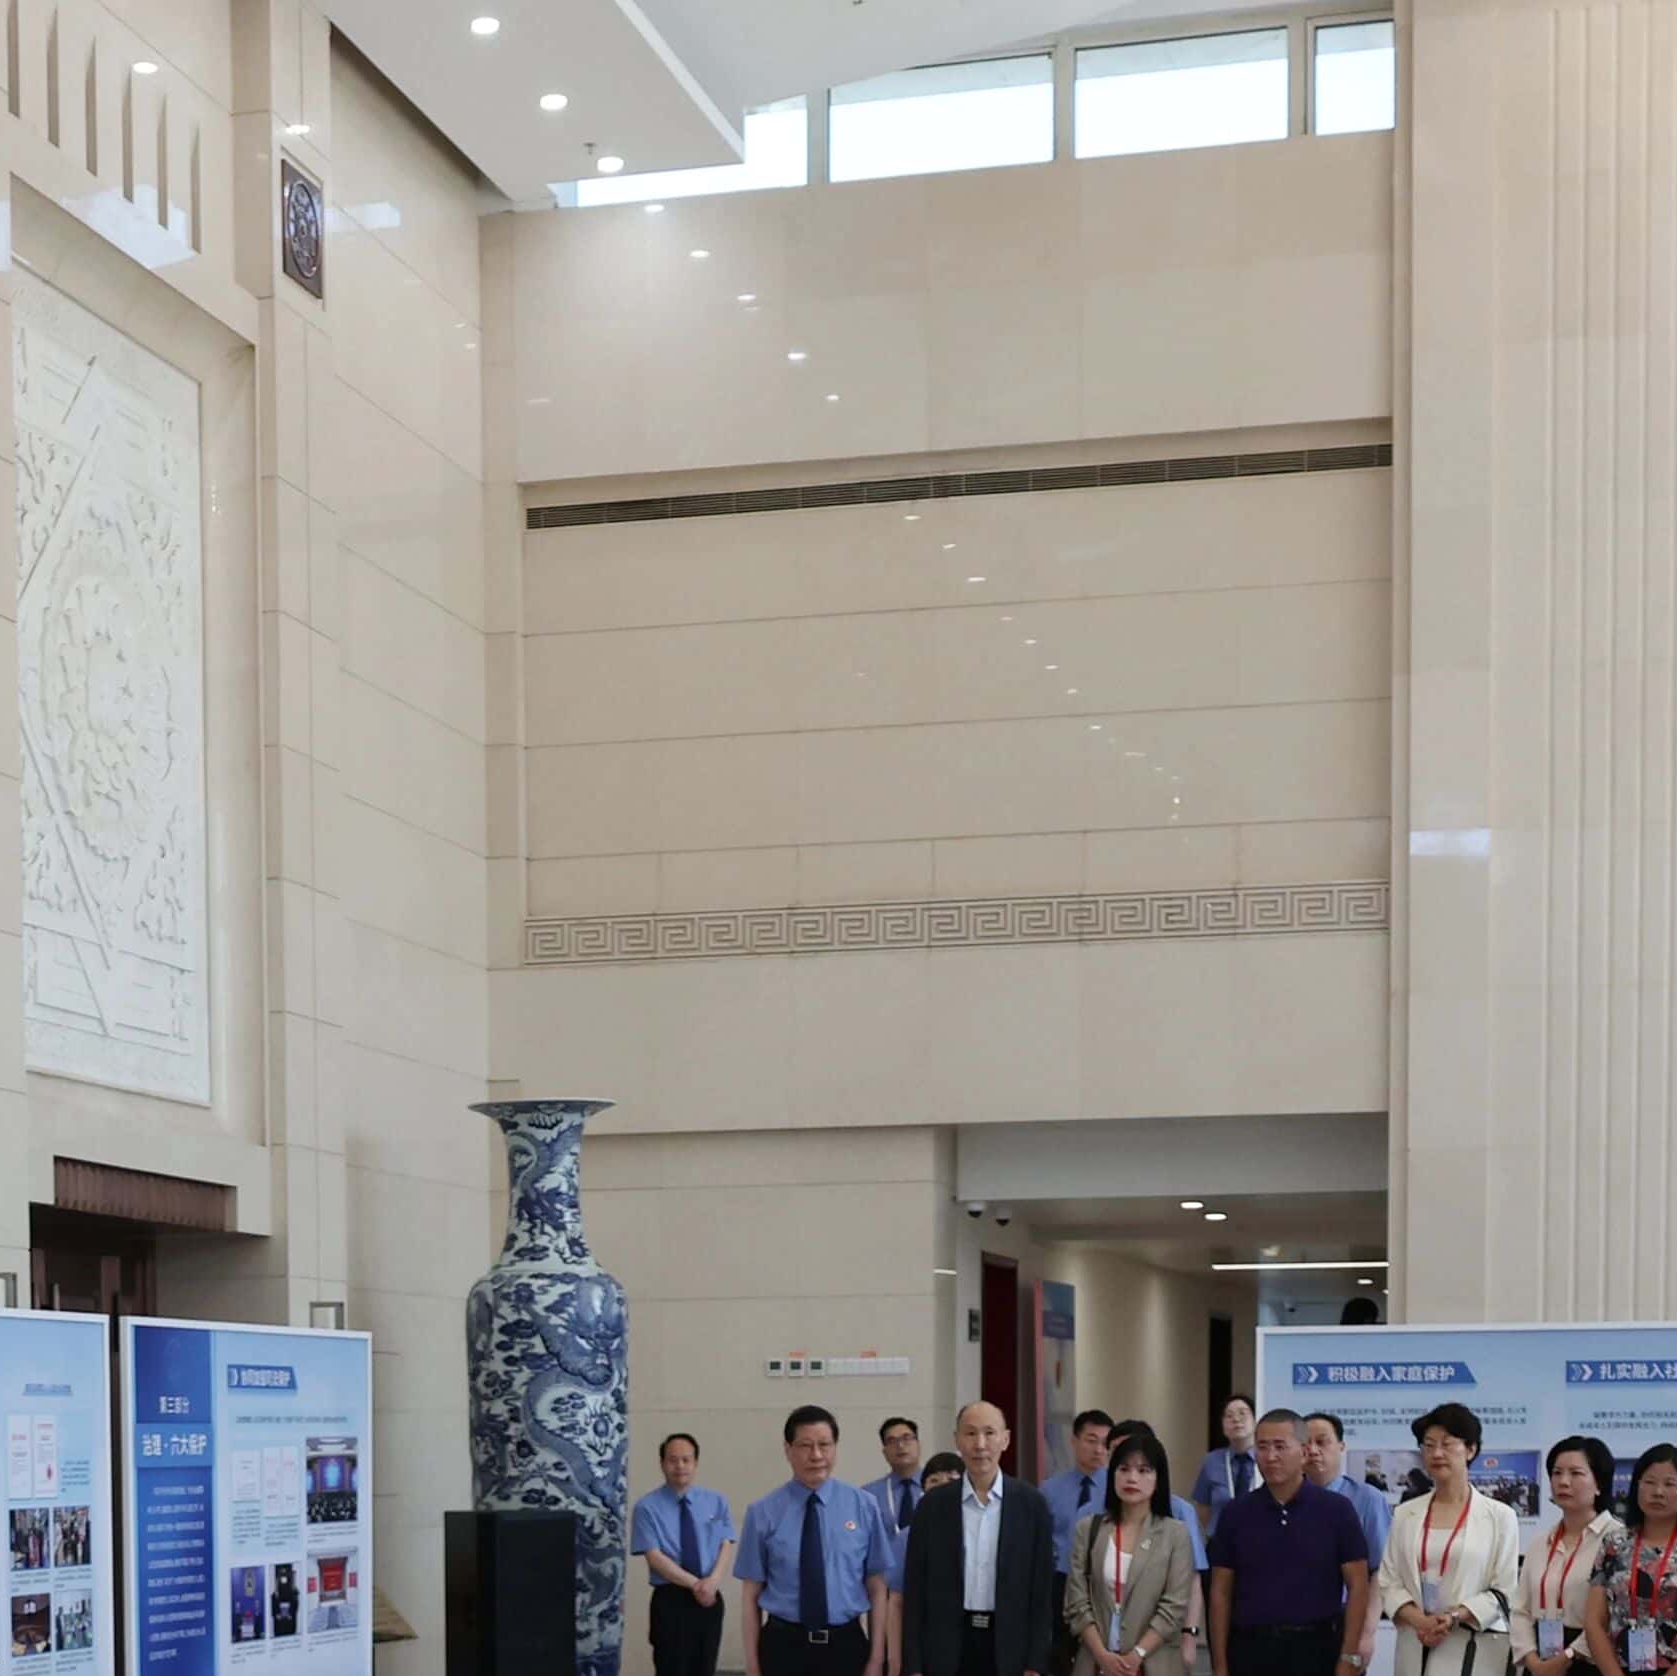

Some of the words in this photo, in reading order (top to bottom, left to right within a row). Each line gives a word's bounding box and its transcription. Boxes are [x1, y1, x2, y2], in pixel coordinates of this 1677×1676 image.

[1327, 1365, 1456, 1382] 积极融入家庭保护
